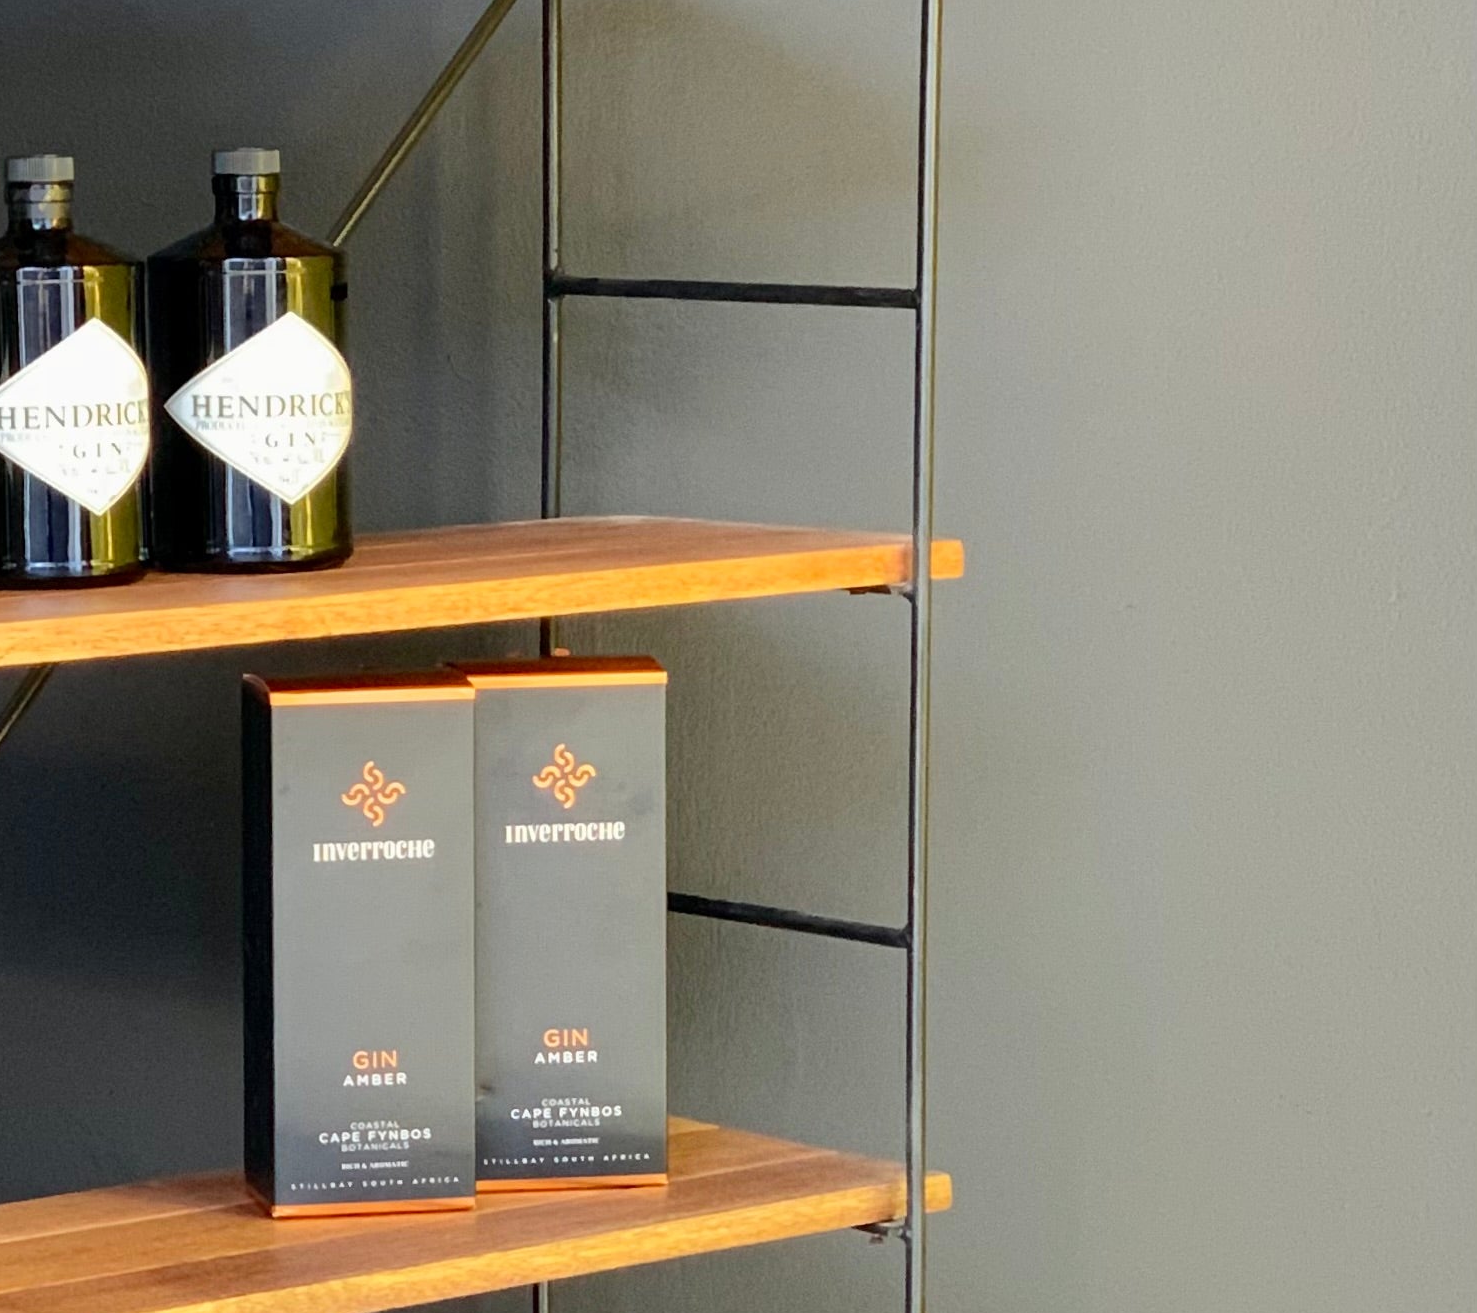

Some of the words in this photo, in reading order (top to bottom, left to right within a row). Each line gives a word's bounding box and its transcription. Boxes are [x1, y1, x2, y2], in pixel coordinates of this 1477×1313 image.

[265, 432, 316, 447] GIN
[73, 442, 122, 458] GIN
[543, 1028, 589, 1048] GIN
[353, 1050, 398, 1069] GIN
[534, 1050, 598, 1064] AMBER
[343, 1072, 408, 1087] AMBER
[541, 1098, 591, 1107] COASTAL
[510, 1108, 552, 1120] CAPE
[559, 1105, 623, 1118] FYNBOS
[350, 1120, 400, 1130] COASTAL
[532, 1118, 601, 1128] BOTANICALS
[318, 1131, 361, 1144] CAPE
[368, 1128, 432, 1142] FYNBOS
[341, 1141, 410, 1153] BOTANICALS
